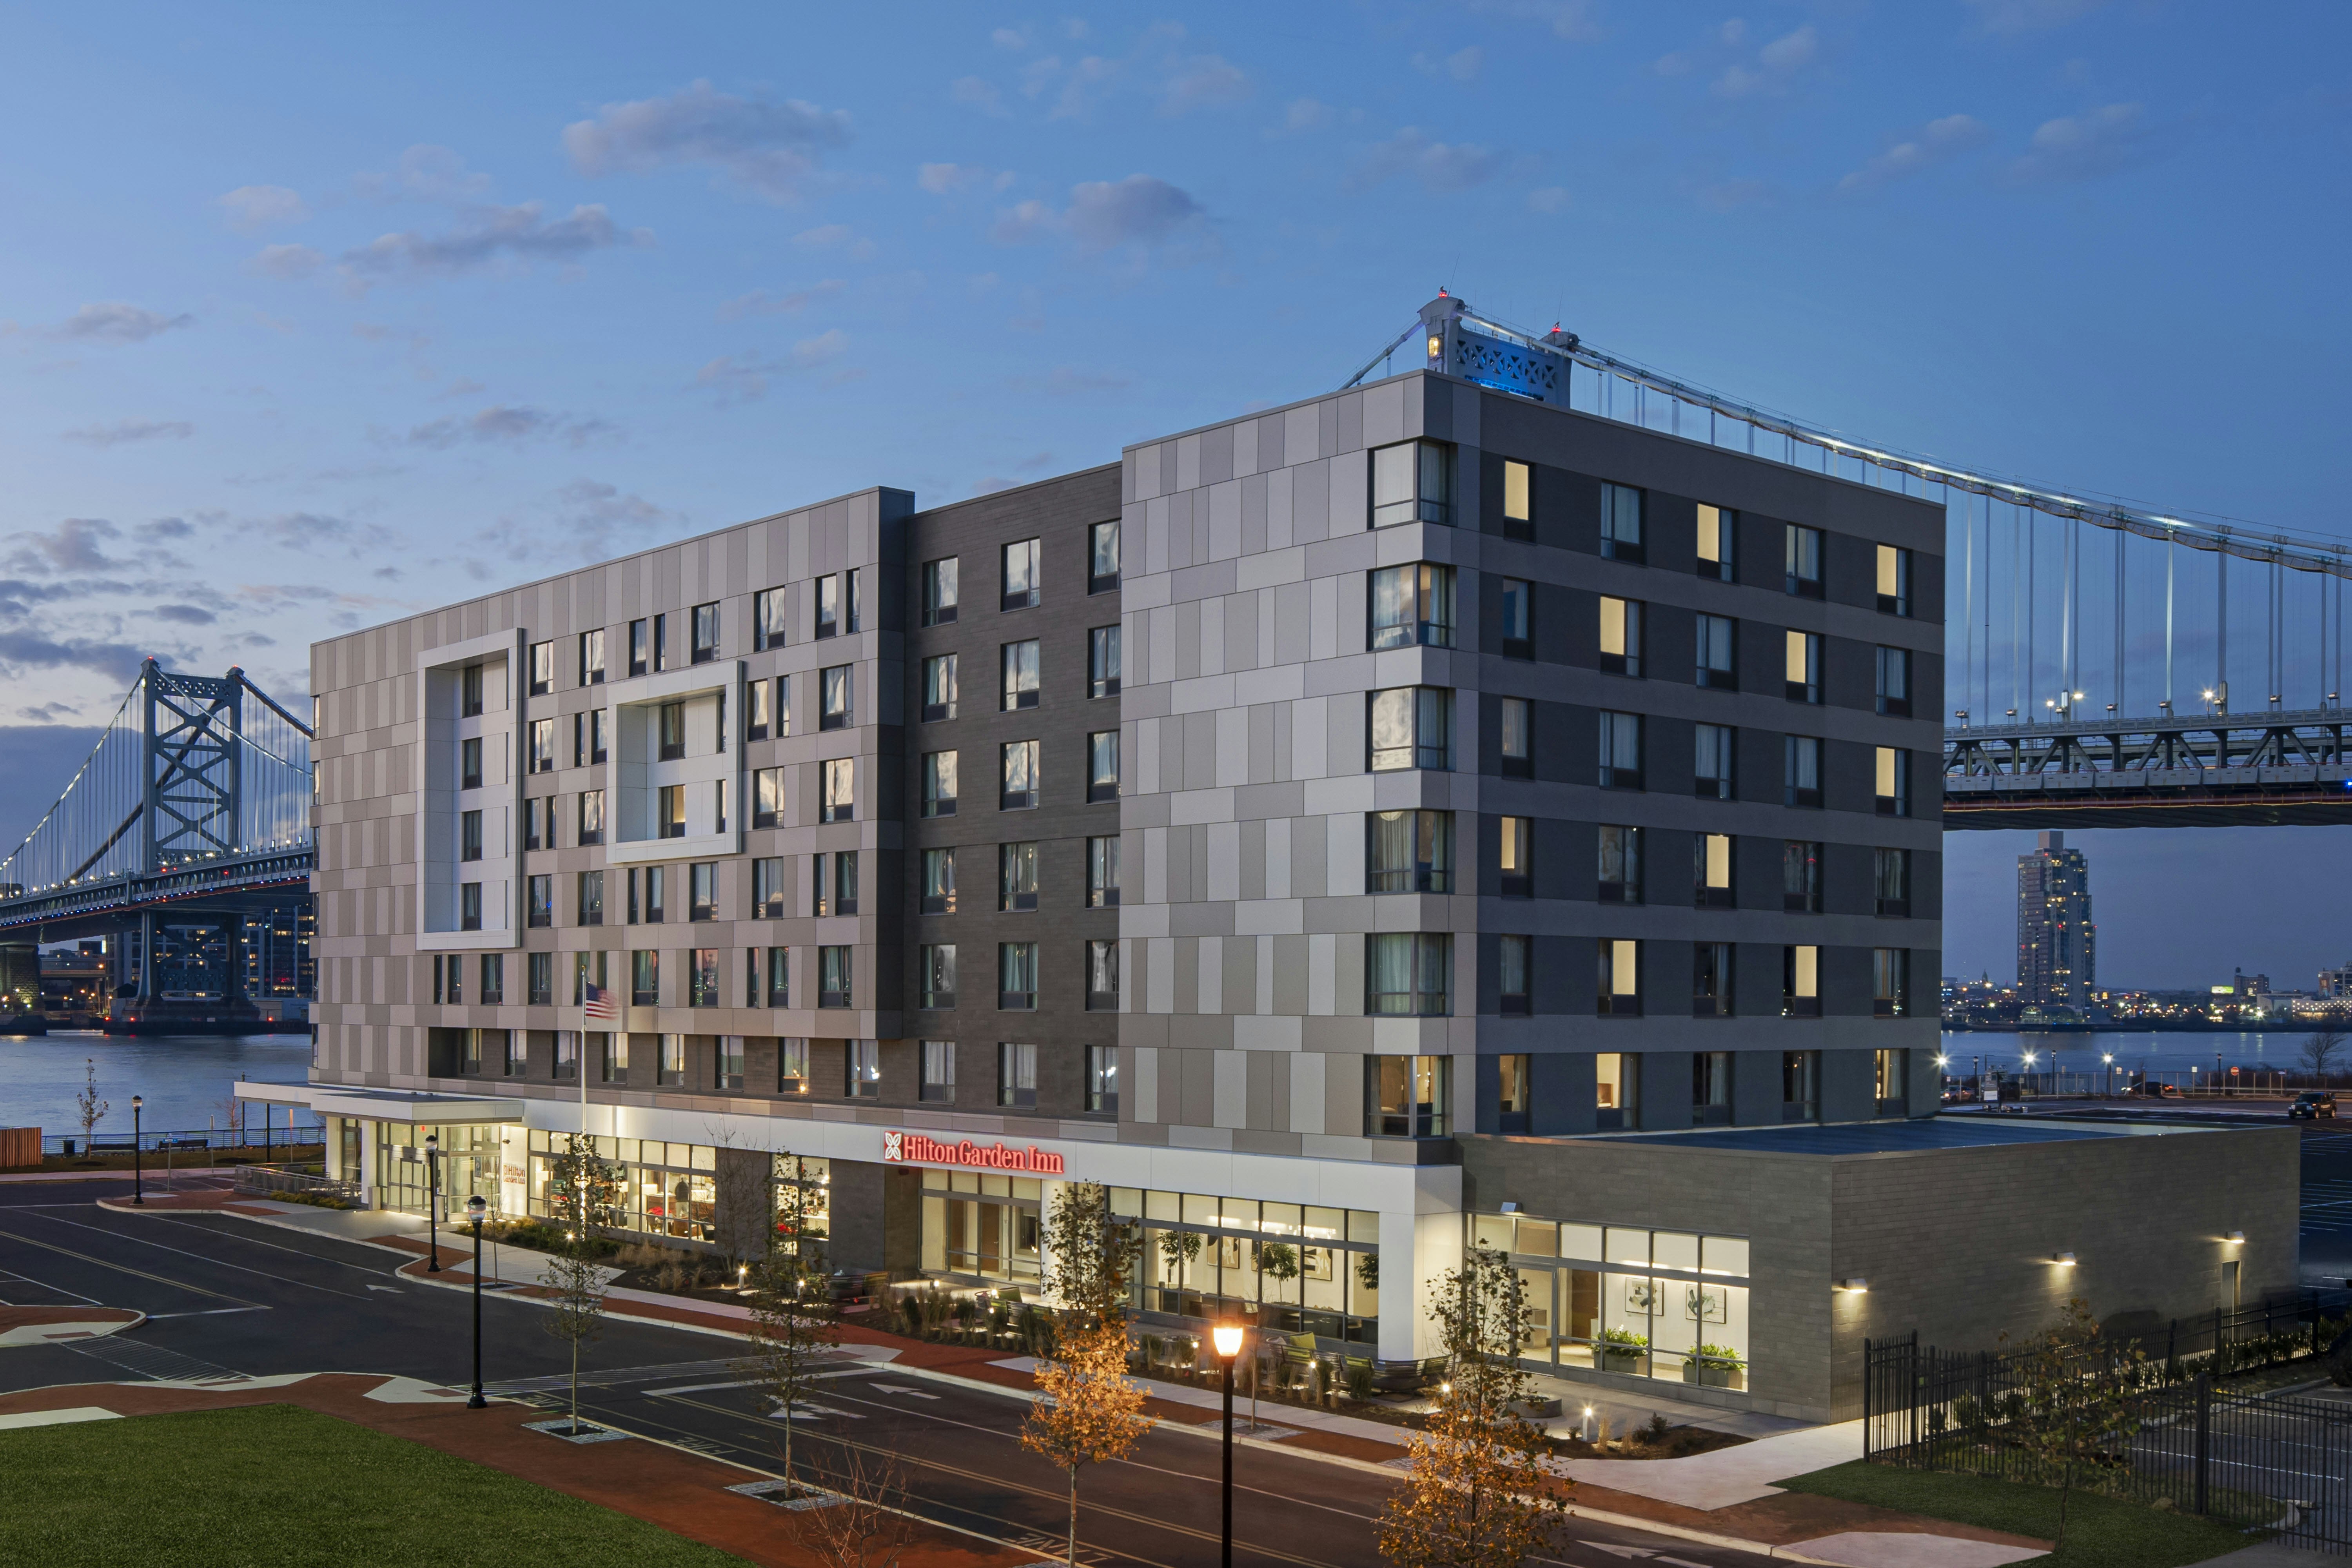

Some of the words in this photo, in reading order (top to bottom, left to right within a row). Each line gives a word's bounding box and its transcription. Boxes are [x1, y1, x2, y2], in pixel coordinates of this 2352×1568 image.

[904, 1136, 957, 1163] Hilton
[959, 1140, 1026, 1170] Garden
[1028, 1146, 1064, 1173] Inn
[508, 1165, 525, 1177] Hilton
[660, 1437, 737, 1455] FIRE
[1001, 1533, 1115, 1563] LANE
